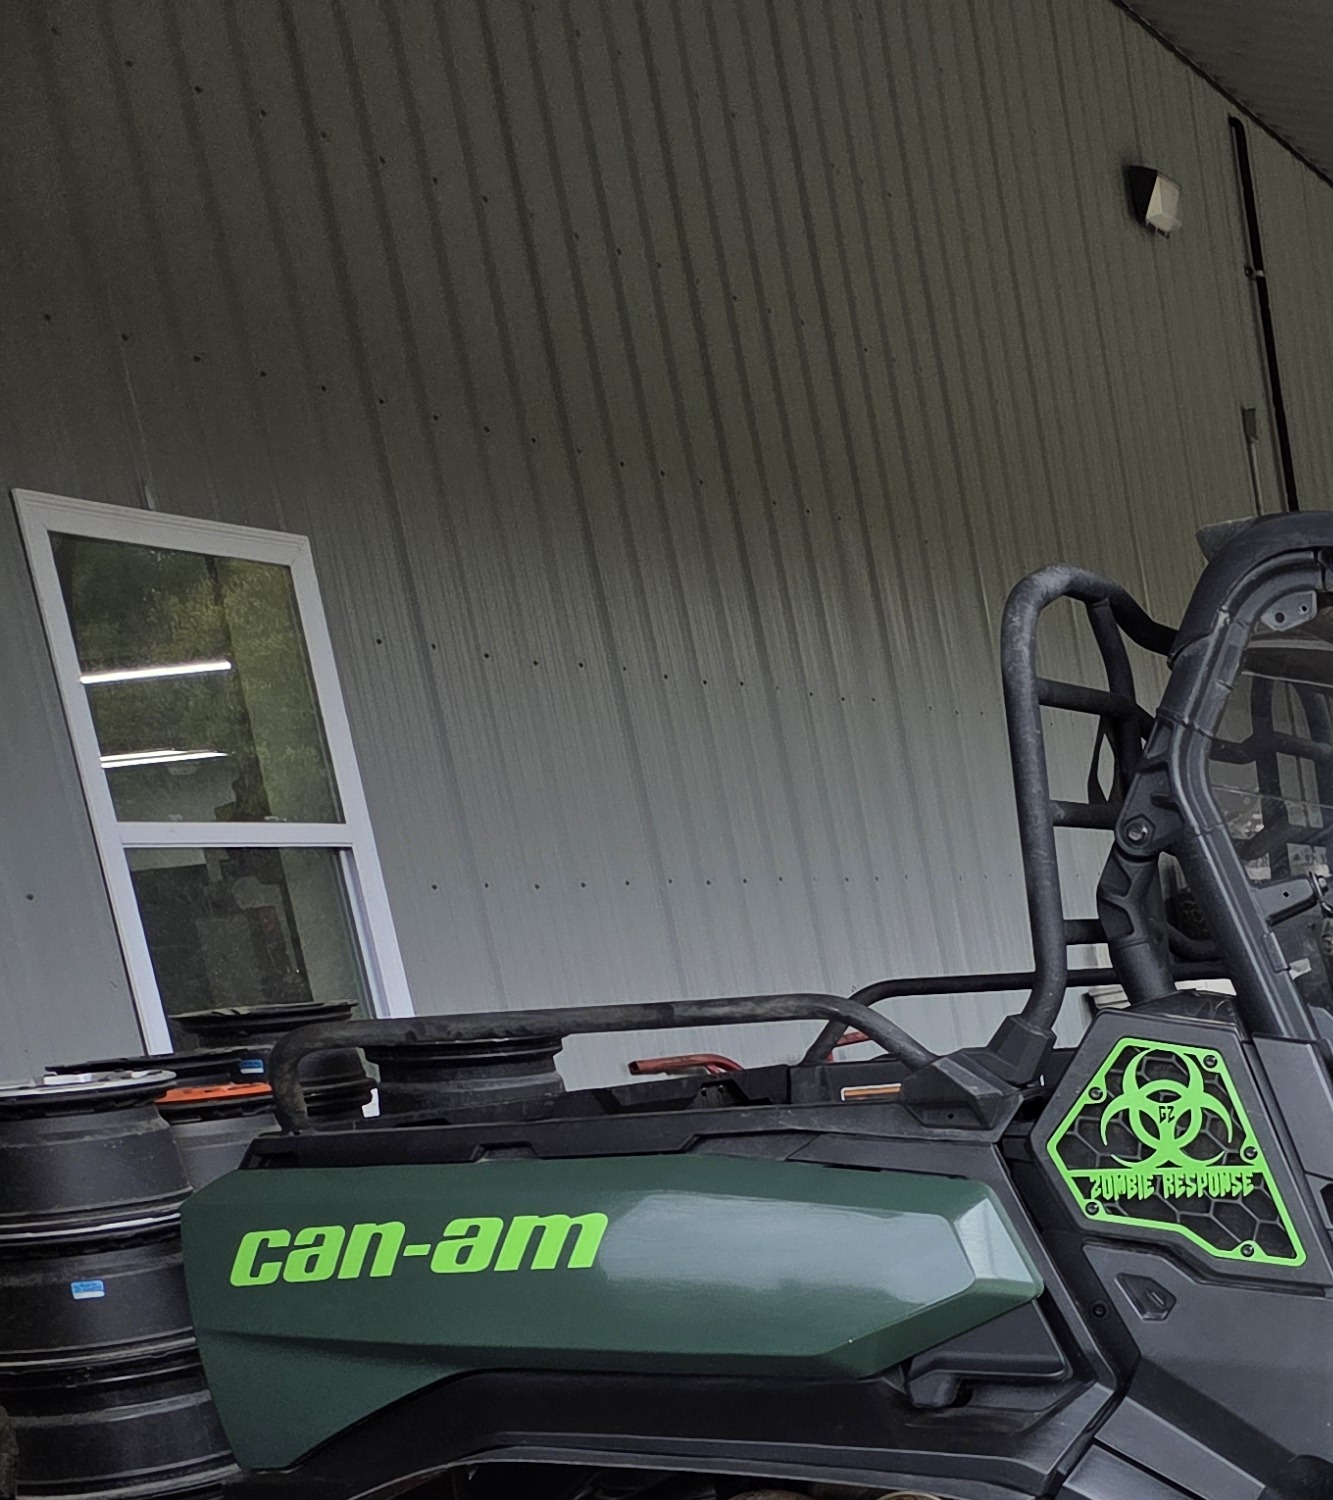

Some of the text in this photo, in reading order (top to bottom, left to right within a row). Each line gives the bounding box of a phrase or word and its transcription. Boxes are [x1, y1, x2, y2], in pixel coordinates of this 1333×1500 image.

[1089, 1172, 1255, 1201] ZOMBIE RESPONSE
[230, 1212, 608, 1287] can-am
